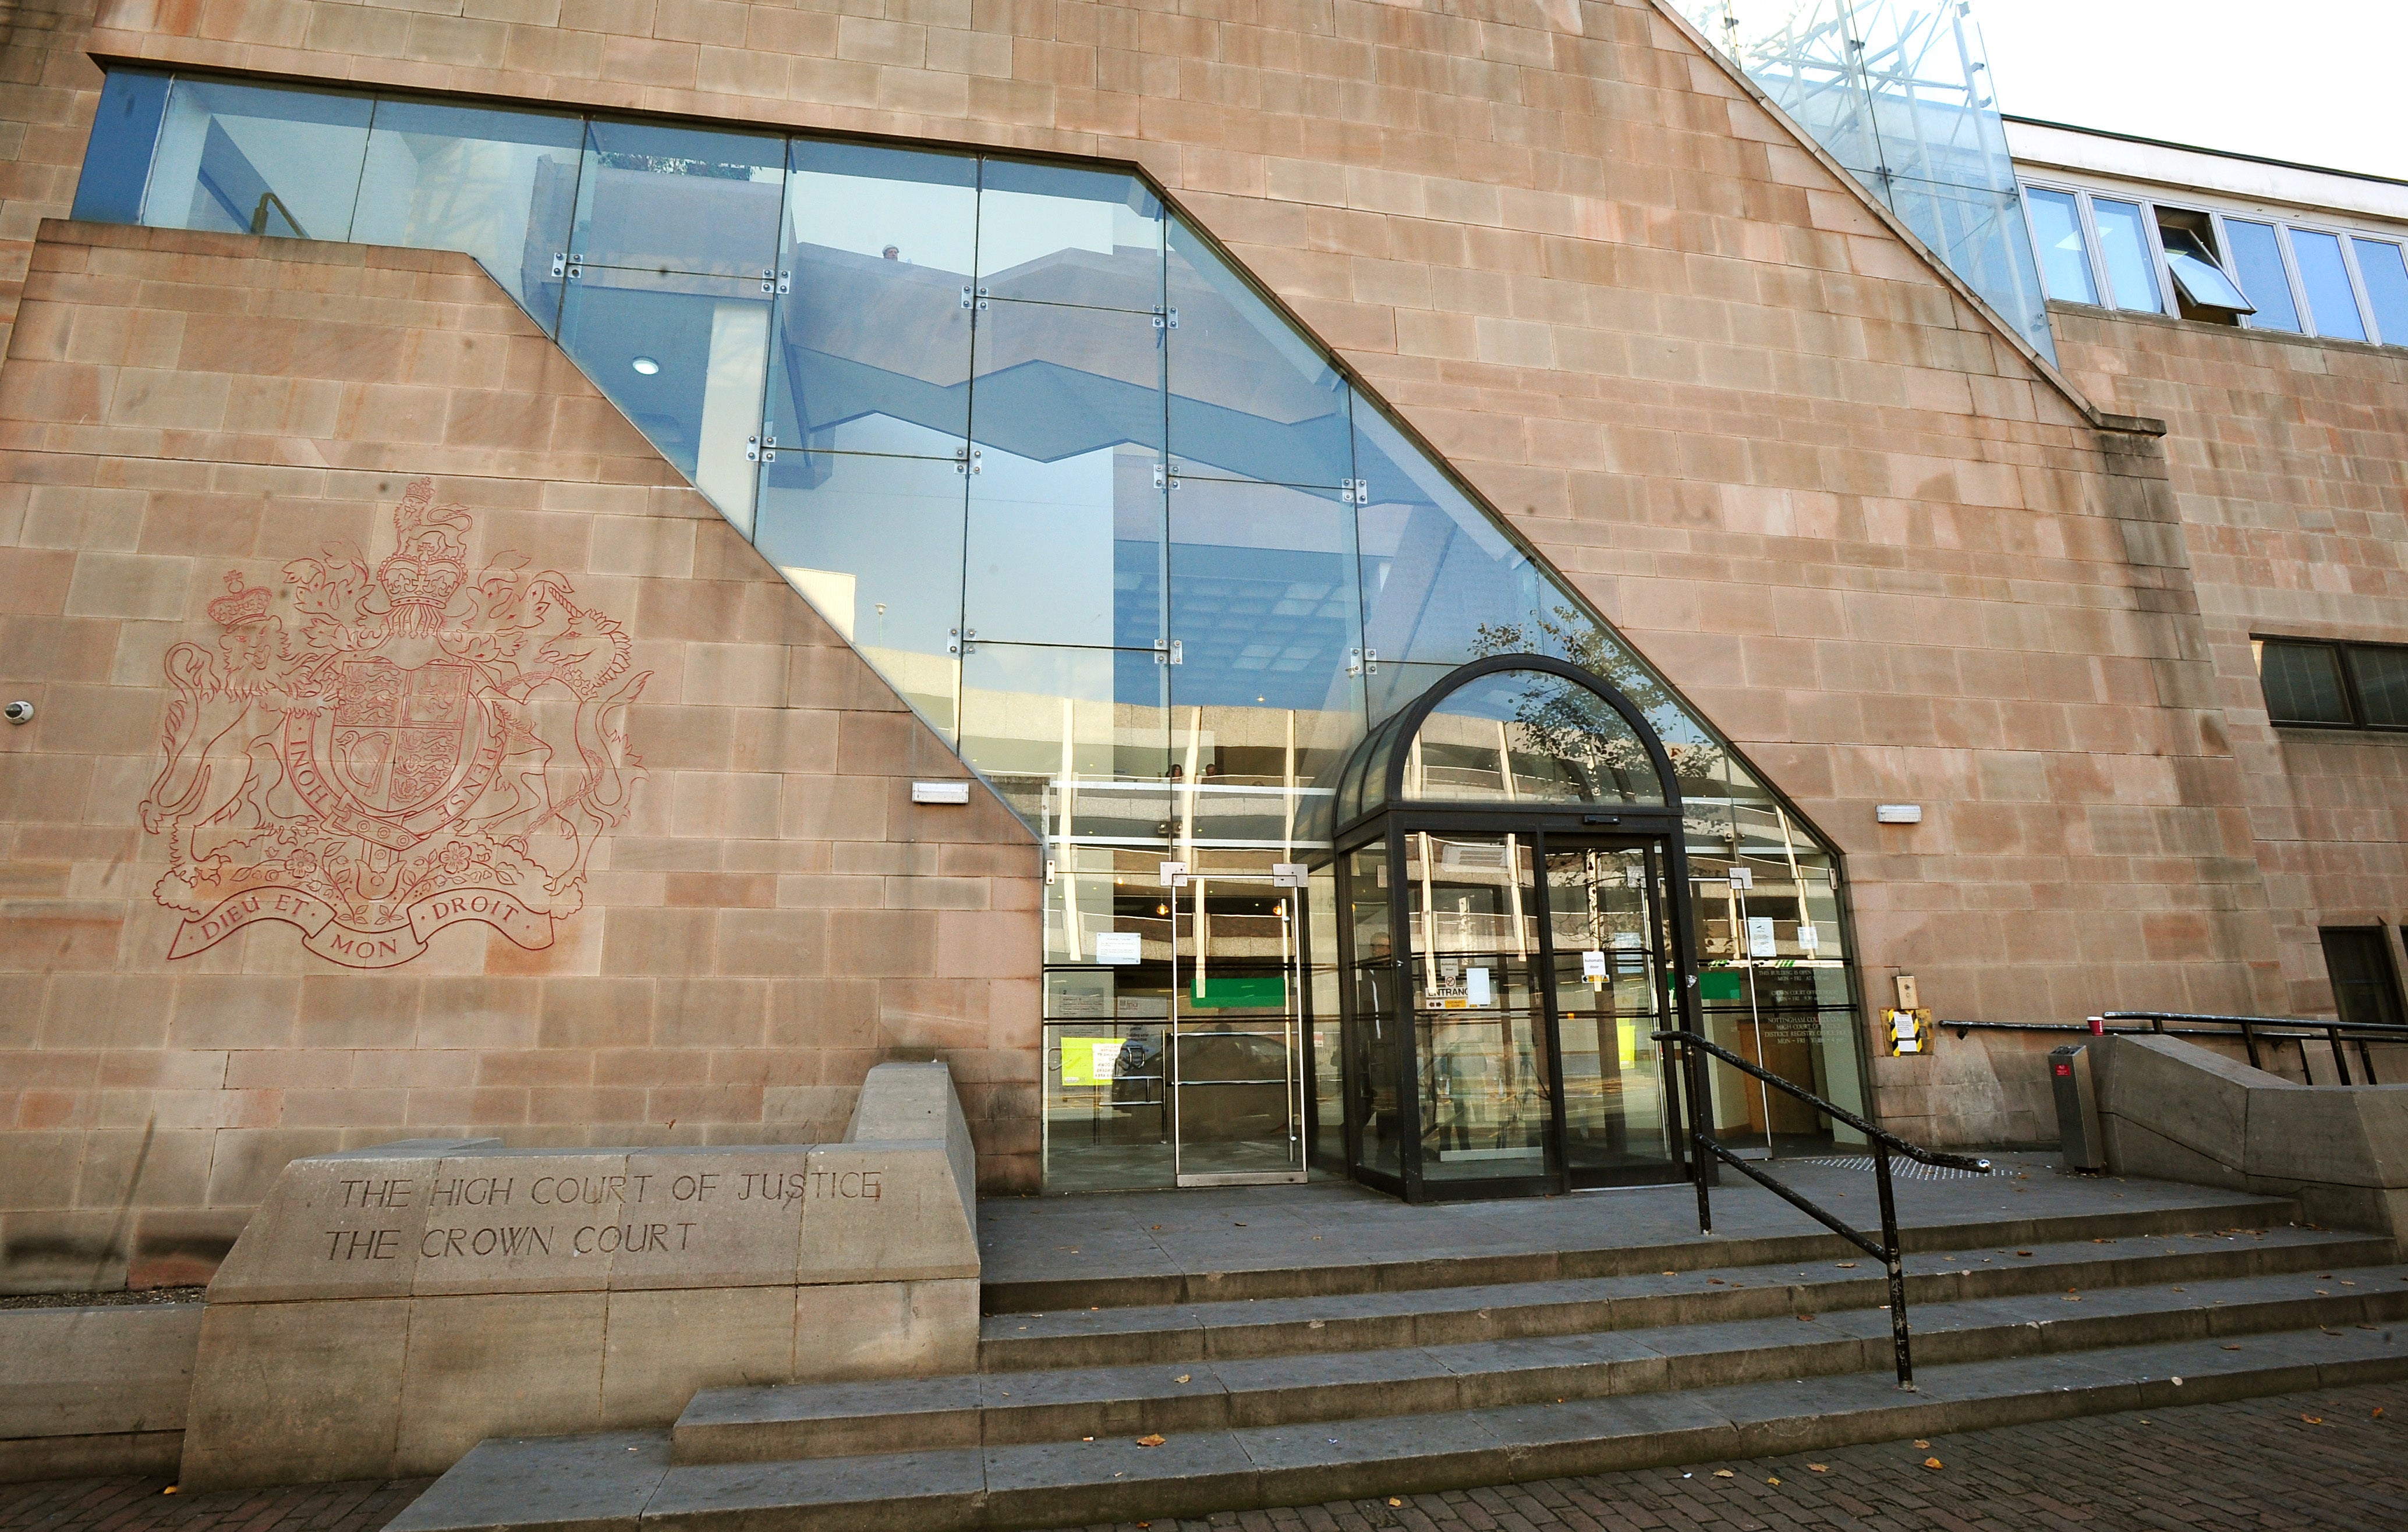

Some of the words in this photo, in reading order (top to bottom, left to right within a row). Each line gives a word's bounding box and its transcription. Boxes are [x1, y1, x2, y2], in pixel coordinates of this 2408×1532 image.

[291, 740, 328, 803] HONI
[435, 747, 498, 820] PENSE
[201, 896, 260, 939] DIEU
[275, 895, 309, 914] ET
[330, 934, 397, 958] MON
[431, 896, 519, 923] DROIT
[1428, 988, 1468, 996] NTRANC
[340, 1179, 412, 1208] THE
[429, 1178, 513, 1206] HIGH
[531, 1175, 653, 1204] COURT
[672, 1174, 720, 1201] OF
[738, 1172, 881, 1201] JUSTICE
[326, 1229, 400, 1260] THE
[420, 1226, 554, 1258] CROWN
[574, 1223, 696, 1253] COURT
